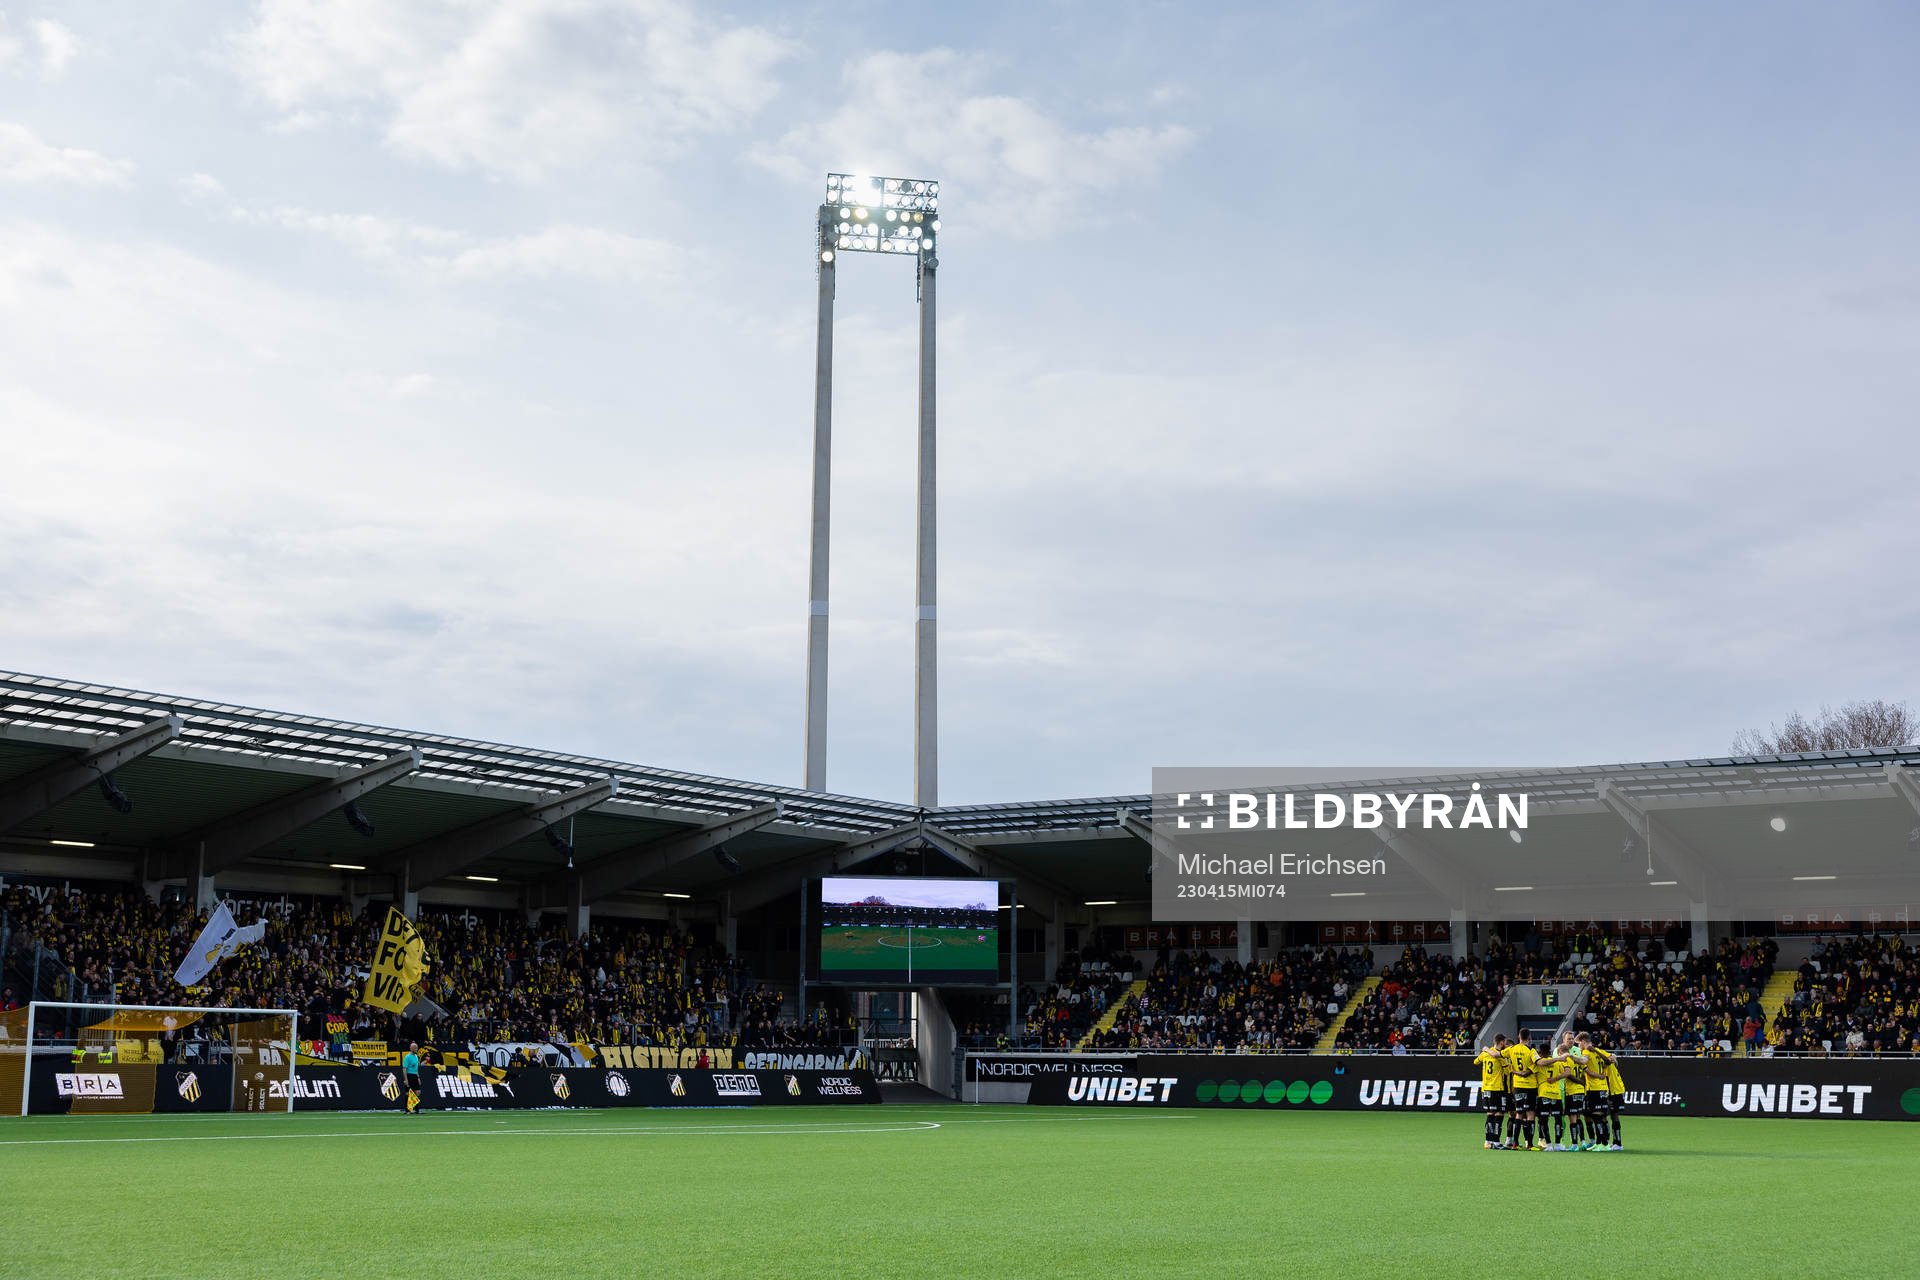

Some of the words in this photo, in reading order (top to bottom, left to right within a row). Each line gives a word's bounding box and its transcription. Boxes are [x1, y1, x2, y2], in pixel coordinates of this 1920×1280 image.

[1129, 929, 1177, 942] BRA
[1325, 925, 1377, 937] BRA
[1393, 923, 1447, 936] BRA
[1546, 994, 1555, 1007] F
[326, 1022, 350, 1035] COPS
[1484, 1061, 1494, 1075] 13
[1517, 1058, 1524, 1071] 5
[62, 1079, 118, 1090] BRA
[821, 1077, 852, 1086] NORDIC
[817, 1086, 862, 1095] WELLNESS
[1067, 1077, 1178, 1102] UNIBET
[1359, 1079, 1483, 1107] UNIBET
[1623, 1091, 1656, 1105] ULLT
[1658, 1091, 1682, 1105] 18+
[1722, 1083, 1873, 1115] UNIBET
